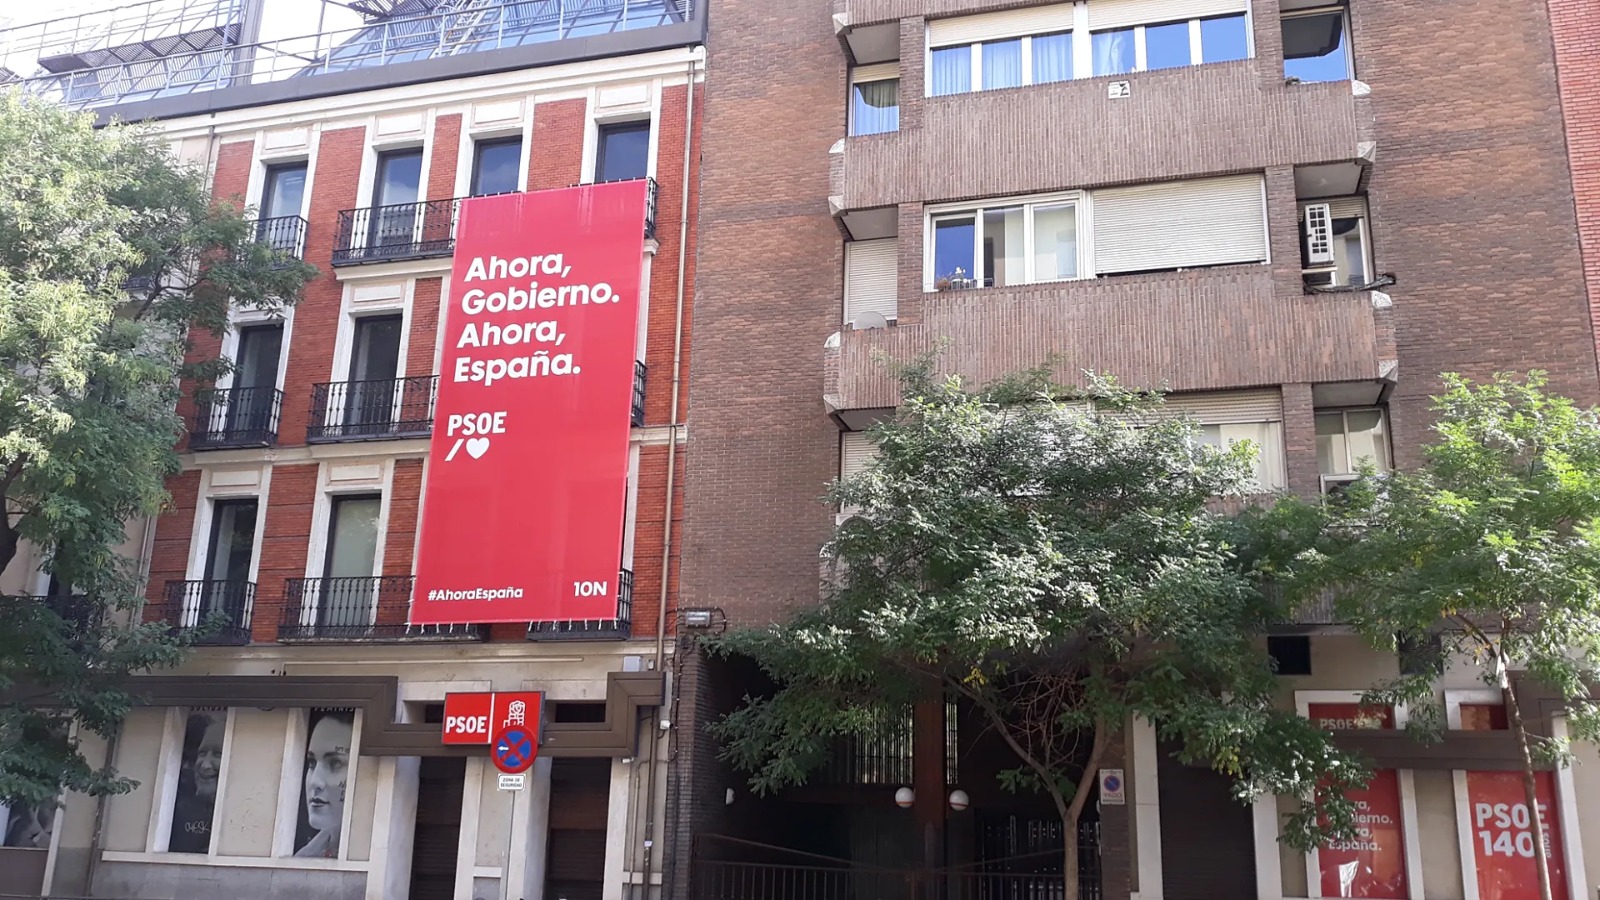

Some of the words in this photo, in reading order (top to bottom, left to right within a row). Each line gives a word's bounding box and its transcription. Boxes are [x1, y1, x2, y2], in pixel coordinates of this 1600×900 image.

[463, 253, 572, 282] Ahora,
[461, 280, 620, 315] Gobierno.
[456, 320, 567, 349] Ahora,
[453, 350, 581, 387] España.
[447, 411, 508, 437] PSOE
[428, 586, 524, 602] #AhoraEspaña
[573, 581, 608, 597] 10N
[445, 716, 487, 734] PSOE
[1319, 718, 1354, 730] PSOE
[1475, 802, 1549, 830] PSOE
[1479, 830, 1535, 858] 140
